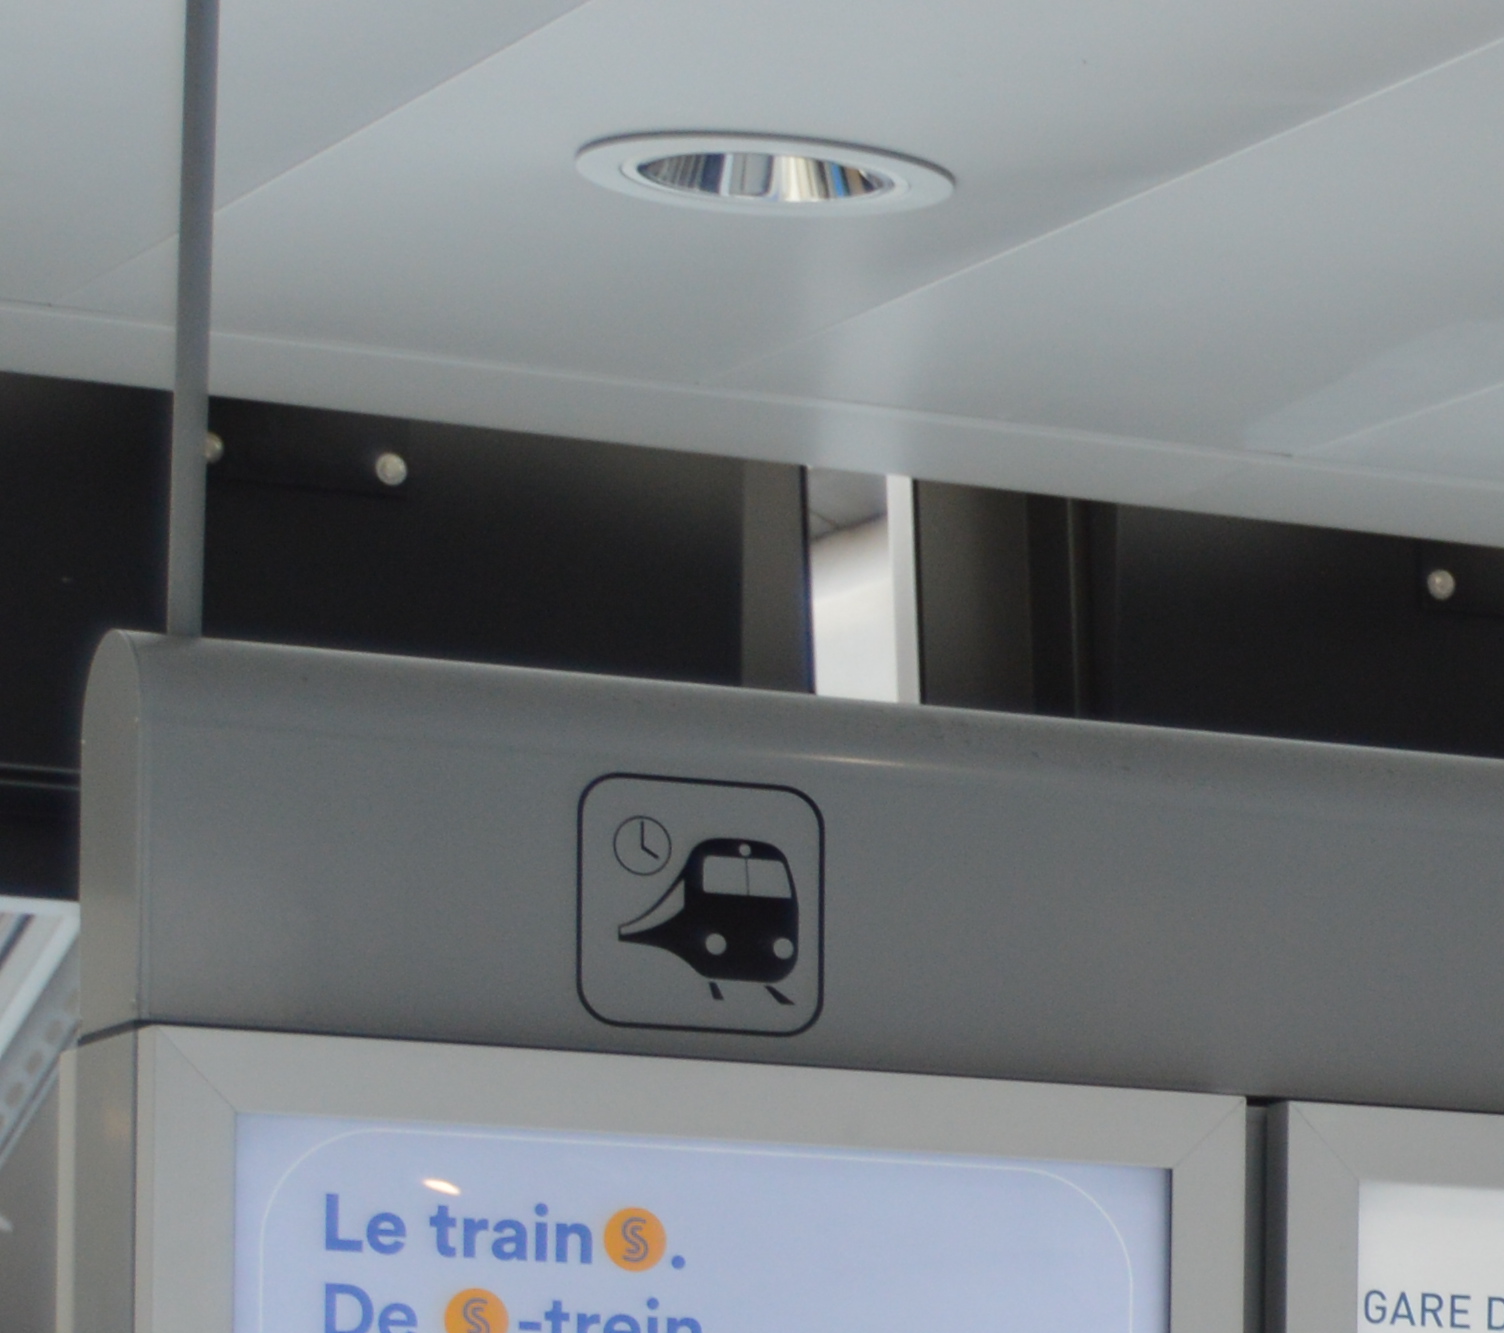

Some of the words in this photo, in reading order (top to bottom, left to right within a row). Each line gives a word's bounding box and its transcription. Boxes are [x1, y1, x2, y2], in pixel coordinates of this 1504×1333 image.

[325, 1193, 406, 1255] Le
[429, 1203, 592, 1264] train
[1364, 1289, 1471, 1329] GARE
